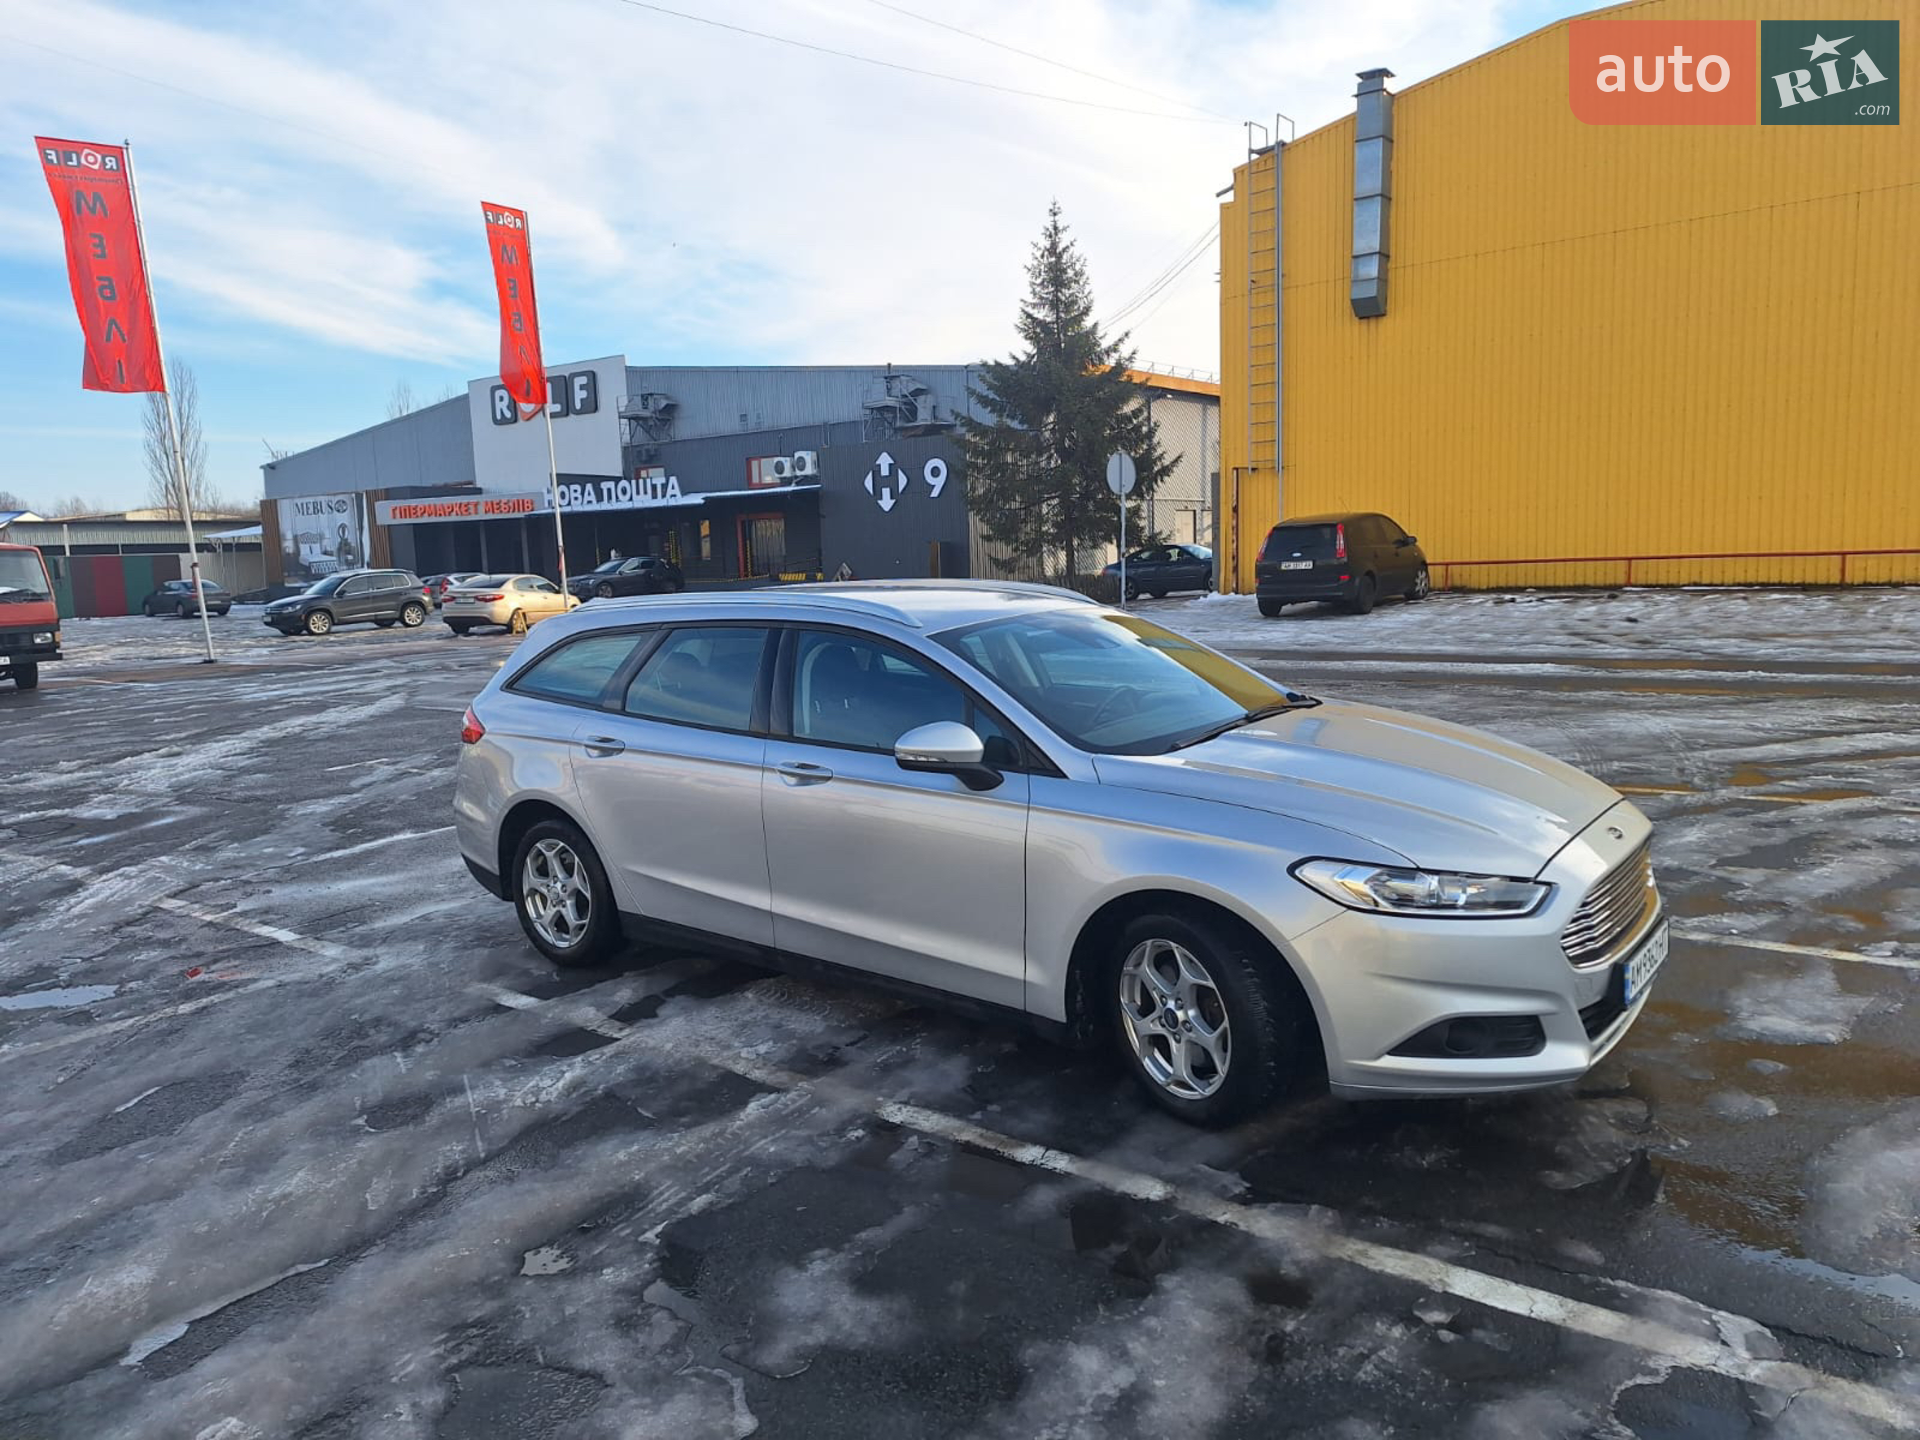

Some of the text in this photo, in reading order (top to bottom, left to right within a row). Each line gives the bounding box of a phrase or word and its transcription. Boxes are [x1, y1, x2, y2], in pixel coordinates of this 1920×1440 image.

[494, 376, 588, 421] RLF
[544, 476, 682, 508] НОВА ПОШТА
[390, 498, 535, 519] ГІПЕРМАРКЕТ МЕБЛІВ
